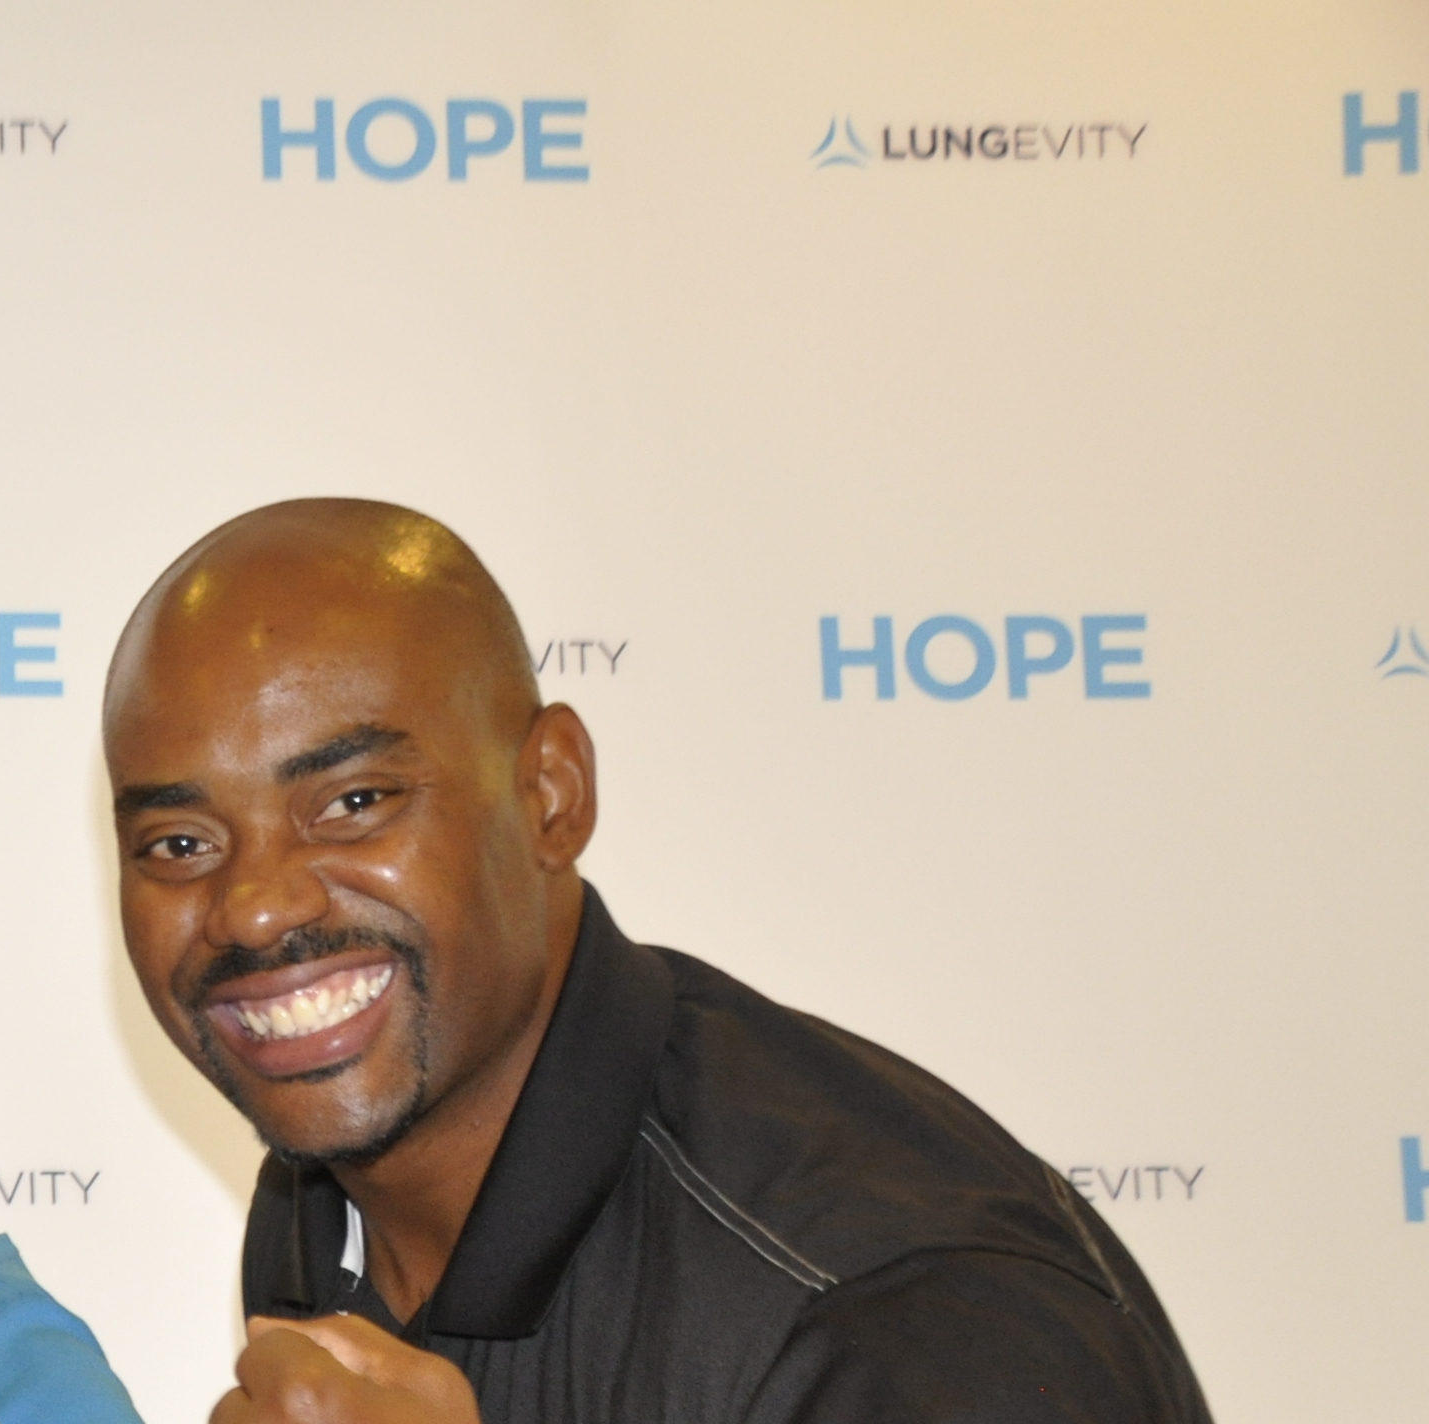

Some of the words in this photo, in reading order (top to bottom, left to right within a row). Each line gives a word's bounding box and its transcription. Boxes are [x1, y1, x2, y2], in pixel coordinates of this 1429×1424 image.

[260, 95, 591, 183] HOPE
[881, 122, 1147, 162] LUNGEVITY
[819, 613, 1153, 703] HOPE
